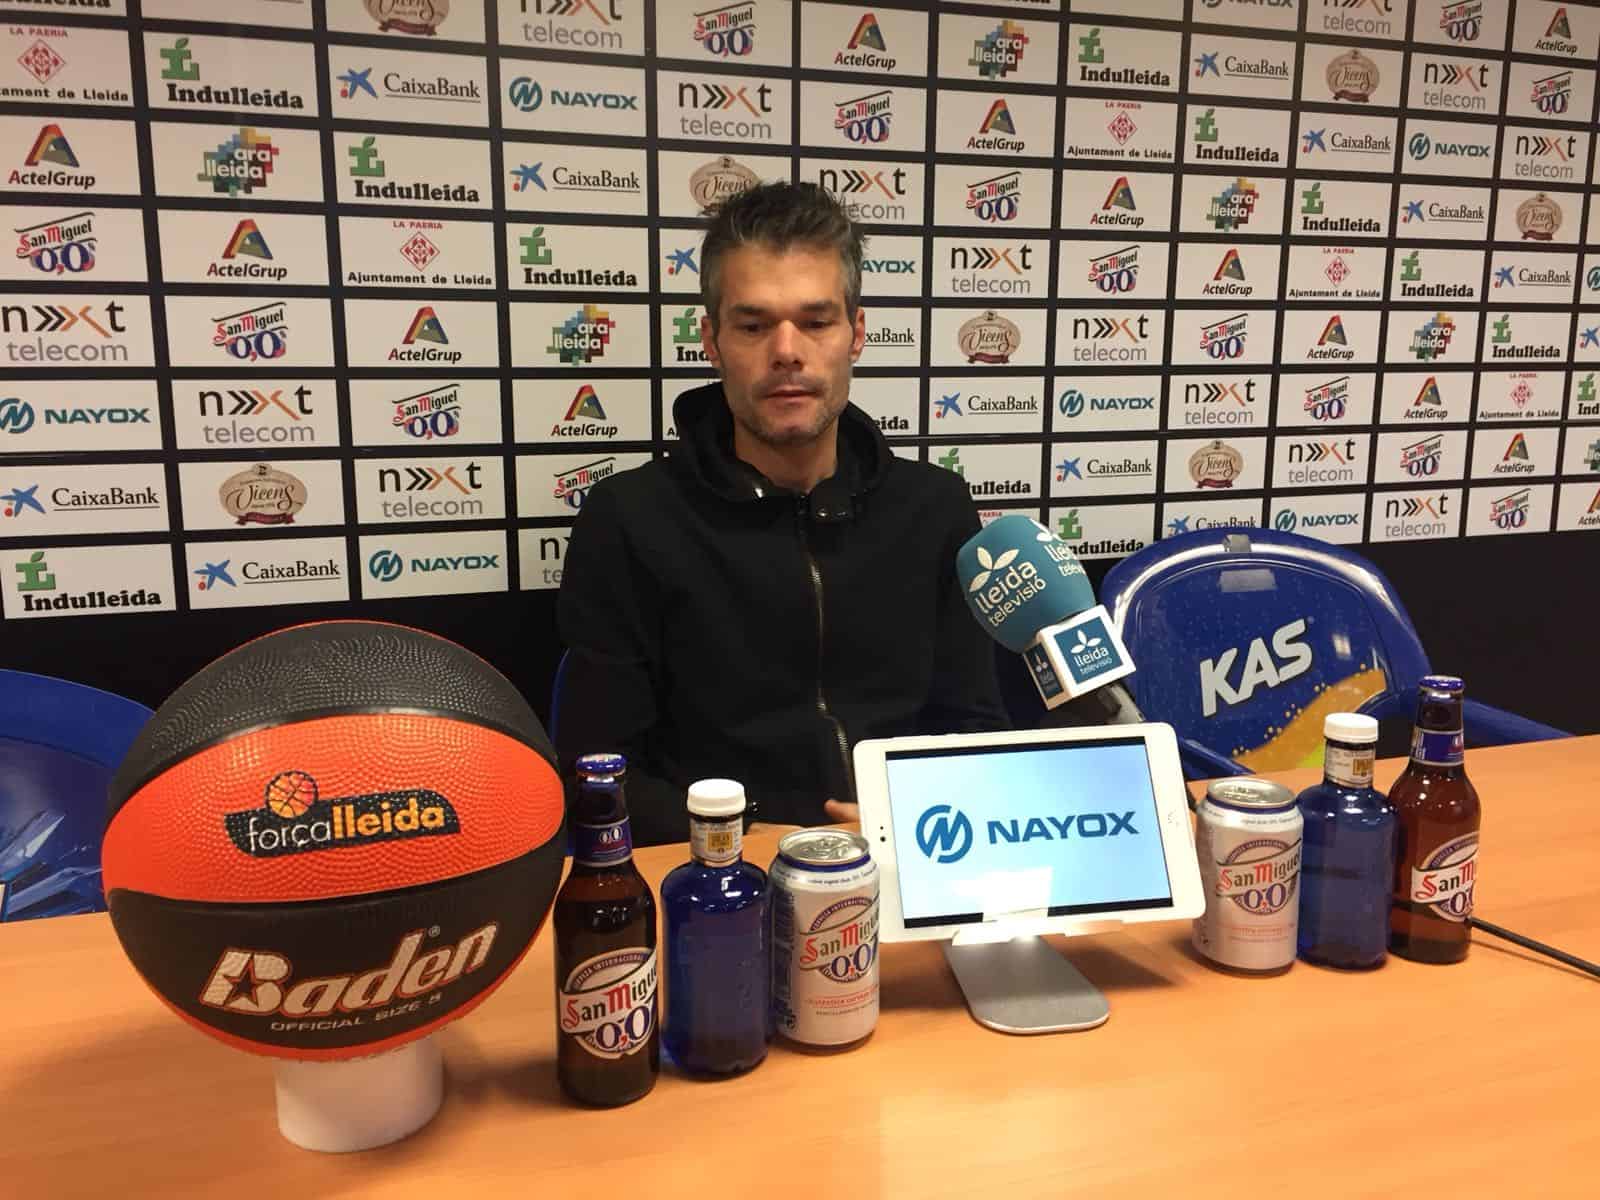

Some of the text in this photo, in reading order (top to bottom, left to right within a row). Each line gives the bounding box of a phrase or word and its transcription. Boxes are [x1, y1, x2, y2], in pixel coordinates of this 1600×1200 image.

[1323, 13, 1392, 35] telecom
[522, 20, 622, 48] telecom
[996, 37, 1023, 49] ara
[1536, 40, 1578, 54] ActelGrup
[834, 52, 896, 71] ActelGrup
[975, 49, 1017, 64] lleida
[1225, 56, 1289, 76] CaixaBank
[1080, 65, 1170, 87] Indulleida
[384, 73, 480, 98] CaixaBank
[57, 88, 75, 99] de
[83, 89, 129, 101] Lleida
[167, 83, 304, 110] Indulleida
[551, 90, 637, 110] NAYOX
[1424, 89, 1486, 110] telecom
[680, 115, 772, 139] telecom
[968, 137, 1025, 153] ActelGrup
[1331, 133, 1391, 152] CaixaBank
[1435, 143, 1489, 157] NAYOX
[234, 146, 271, 163] ara
[1068, 146, 1172, 159] Ajuntament de Lleida
[1195, 144, 1279, 163] Indulleida
[205, 160, 264, 179] lleida
[552, 168, 640, 188] CaixaBank
[1515, 161, 1573, 178] telecom
[8, 170, 96, 190] ActelGrup
[354, 179, 480, 203] Indulleida
[1231, 193, 1254, 205] ara
[1212, 204, 1247, 218] lleida
[1429, 205, 1484, 219] CaixaBank
[1091, 213, 1144, 228] ActelGrup
[1302, 216, 1381, 233] Indulleida
[206, 263, 288, 281] ActelGrup
[861, 259, 915, 274] AYOX
[347, 272, 492, 286] Ajuntament de Lleida
[524, 268, 637, 288] Indulleida
[1518, 269, 1571, 283] CaixaBank
[952, 276, 1031, 294] telecom
[1203, 284, 1252, 297] ActelGrup
[1289, 288, 1380, 298] Ajuntament de Lleida
[1401, 284, 1473, 297] Indulleida
[577, 323, 609, 335] ara
[865, 327, 915, 344] xaBank
[8, 337, 128, 361] telecom
[553, 335, 602, 349] lleida
[388, 349, 462, 365] ActelGrup
[1074, 345, 1147, 362] telecom
[1307, 348, 1354, 360] ActelGrup
[1492, 345, 1560, 358] Indulleida
[968, 397, 1038, 412] CaixaBank
[1090, 398, 1154, 410] NAYOX
[45, 408, 152, 424] NAYOX
[1185, 409, 1253, 424] telecom
[1404, 408, 1448, 419] ActelGrup
[203, 420, 314, 443] telecom
[551, 424, 617, 438] ActelGrup
[1088, 460, 1152, 474] CaixaBank
[1289, 466, 1353, 483] telecom
[1494, 463, 1534, 473] ActelGrup
[968, 480, 1031, 495] ulleida
[52, 488, 159, 506] CaixaBank
[382, 496, 483, 518] telecom
[1302, 513, 1358, 526] NAYOX
[1386, 520, 1446, 538] telecom
[1068, 540, 1143, 555] ndulleida
[242, 560, 340, 580] CaixaBank
[412, 555, 500, 571] NAYOX
[975, 561, 1037, 611] lleida
[23, 589, 162, 612] Indulleida
[989, 576, 1047, 627] televisió
[1073, 646, 1109, 667] lleida
[1200, 619, 1312, 717] KAS
[987, 811, 1140, 845] NAYOX
[202, 922, 497, 1017] Baden
[271, 1017, 366, 1032] OFFICIAL
[376, 1000, 423, 1021] SIZE
